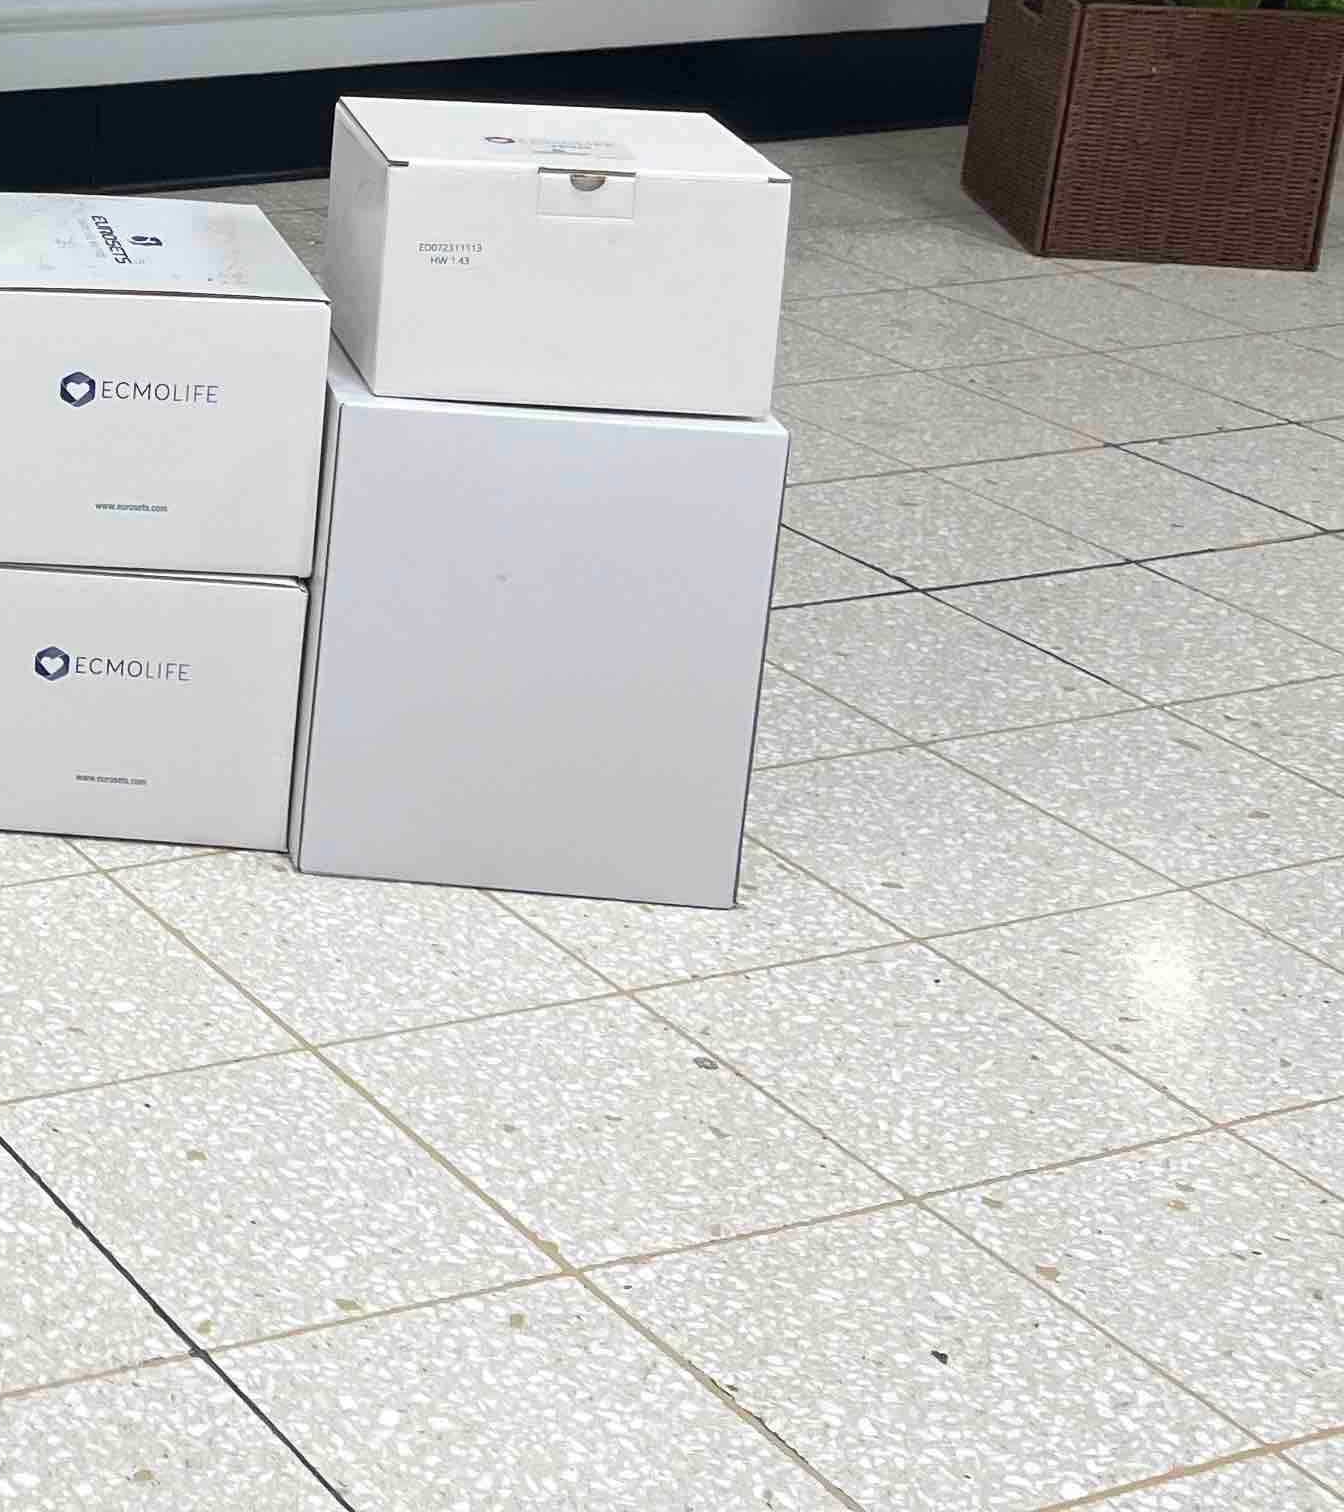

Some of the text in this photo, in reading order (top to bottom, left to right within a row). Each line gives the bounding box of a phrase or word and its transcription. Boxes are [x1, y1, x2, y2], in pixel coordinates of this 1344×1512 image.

[91, 215, 133, 265] EUROSETS
[101, 380, 219, 404] ECMOLIFE
[95, 503, 168, 513] www.eurosets.com
[75, 656, 192, 681] ECMOLIFE
